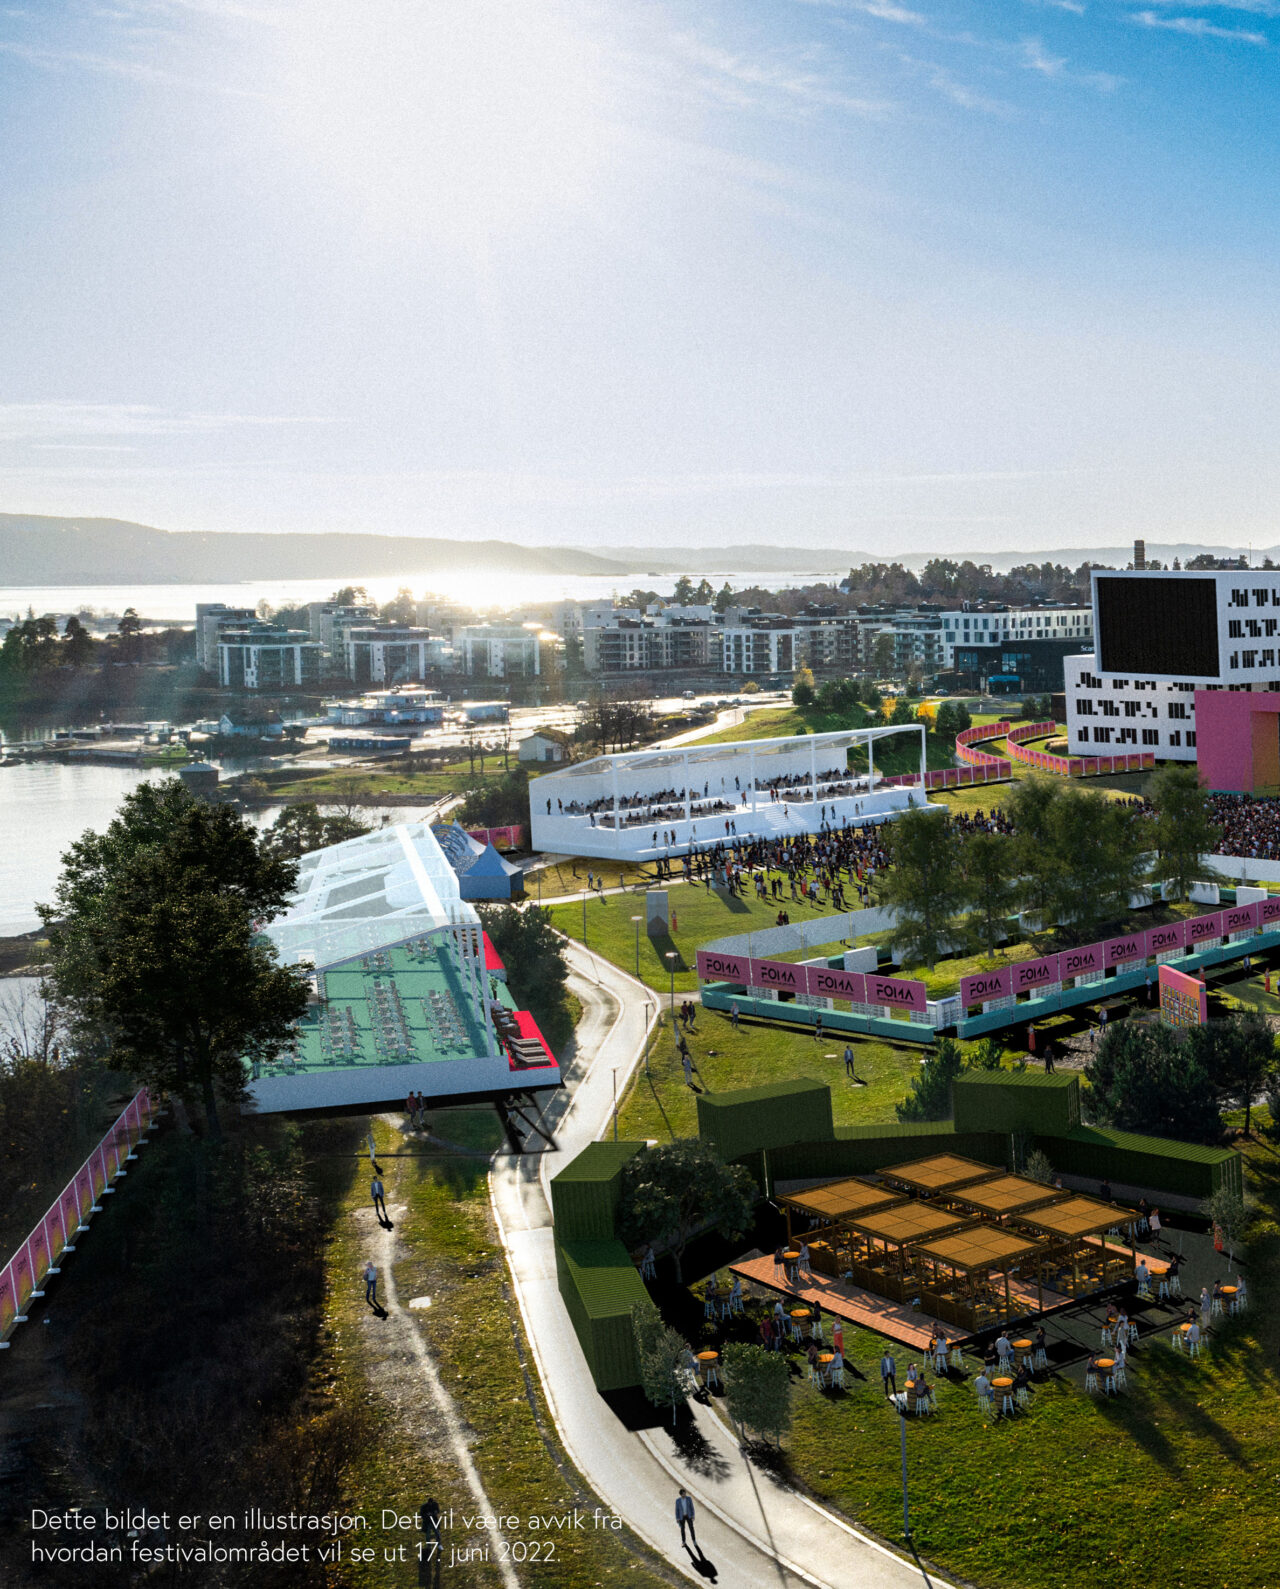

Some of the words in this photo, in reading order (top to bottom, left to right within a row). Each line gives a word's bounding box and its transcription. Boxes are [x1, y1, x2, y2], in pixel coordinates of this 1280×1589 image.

[1110, 942, 1137, 958] FOMA
[706, 958, 740, 975] FOMA
[1066, 953, 1095, 969] FOMA
[761, 966, 796, 984] FOMA
[1020, 965, 1050, 983] FOMA
[817, 975, 854, 992] FOMA
[876, 983, 914, 1000] FOMA
[970, 977, 1002, 996] FOMA
